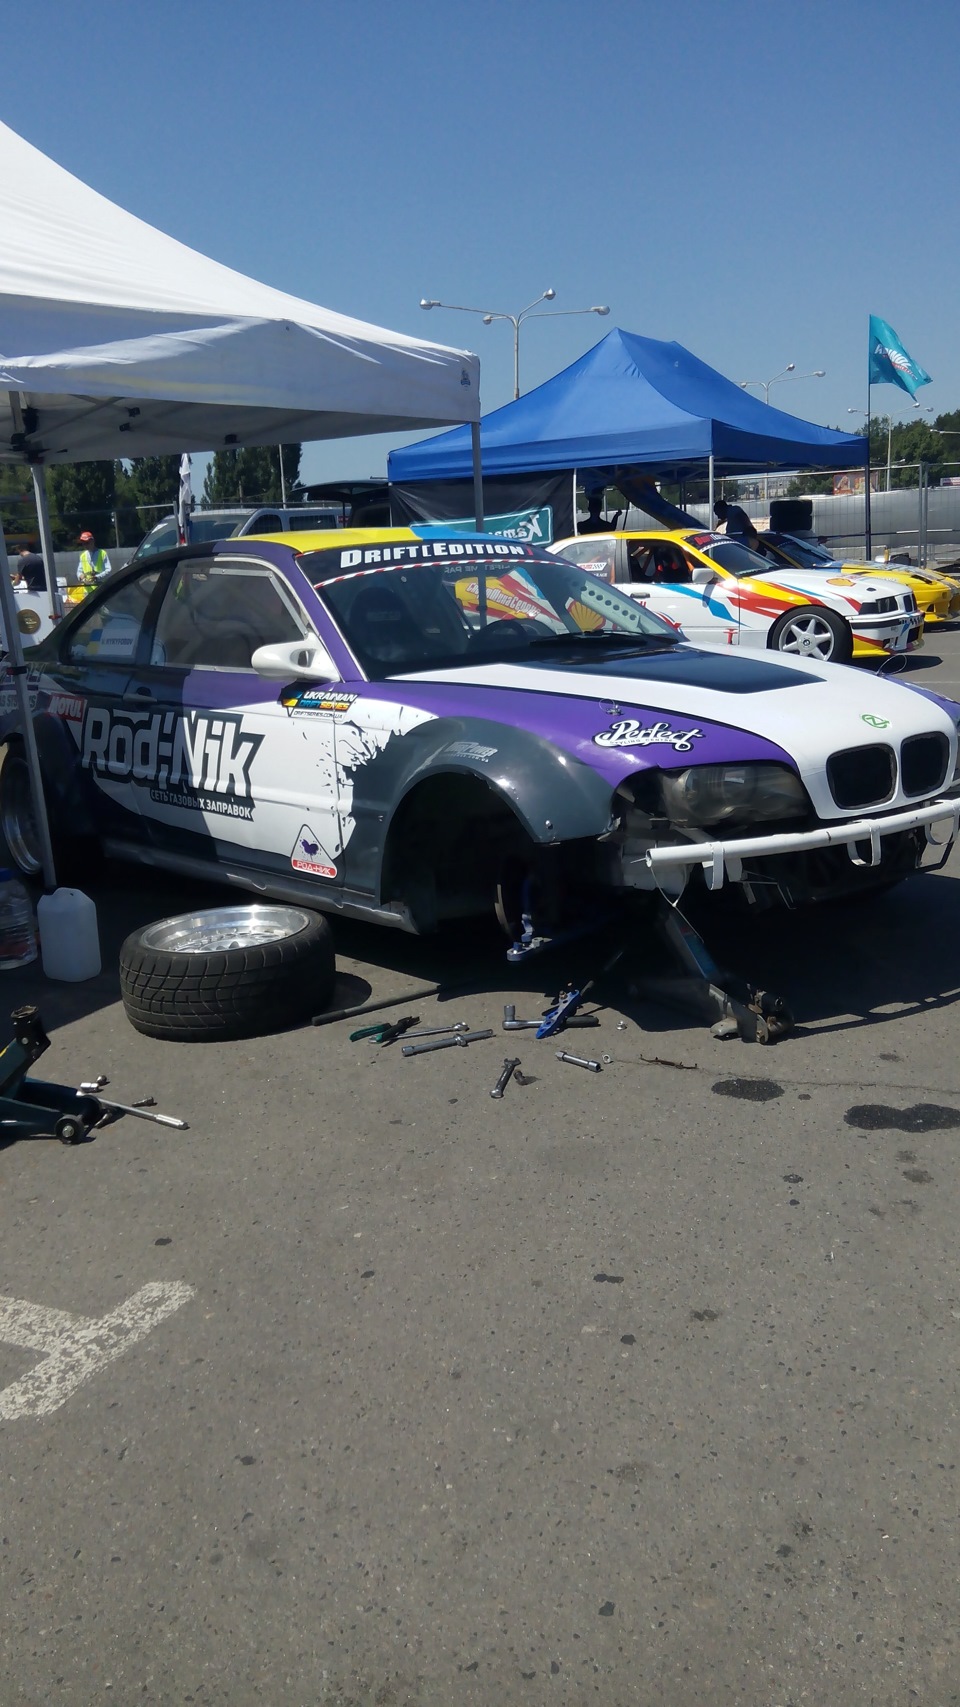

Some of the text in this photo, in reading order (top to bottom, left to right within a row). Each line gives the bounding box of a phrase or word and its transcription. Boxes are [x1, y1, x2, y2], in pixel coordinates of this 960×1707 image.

[47, 696, 82, 719] MOTUL
[303, 691, 358, 702] UKRAINIAN
[594, 719, 703, 751] Perfect
[150, 789, 252, 819] СЕТЬ ГАЗОВЫХ ЗАПРАВОК
